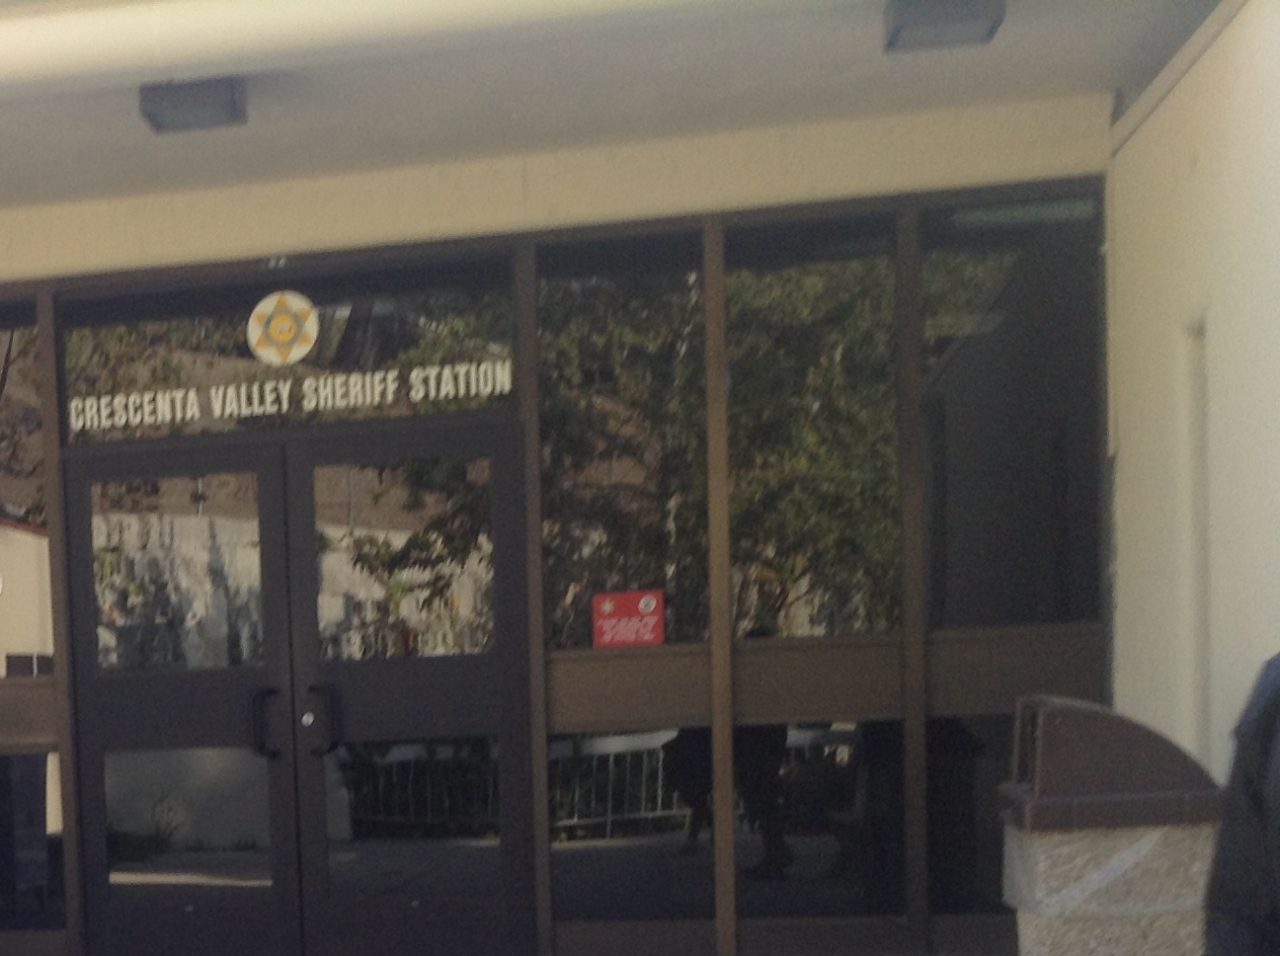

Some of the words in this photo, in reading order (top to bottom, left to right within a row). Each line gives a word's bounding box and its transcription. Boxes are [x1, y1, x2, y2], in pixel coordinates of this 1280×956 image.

[69, 388, 200, 432] CRESCENTA
[211, 377, 293, 420] VALLEY
[302, 368, 400, 412] SHERIFF
[409, 358, 514, 403] STATION
